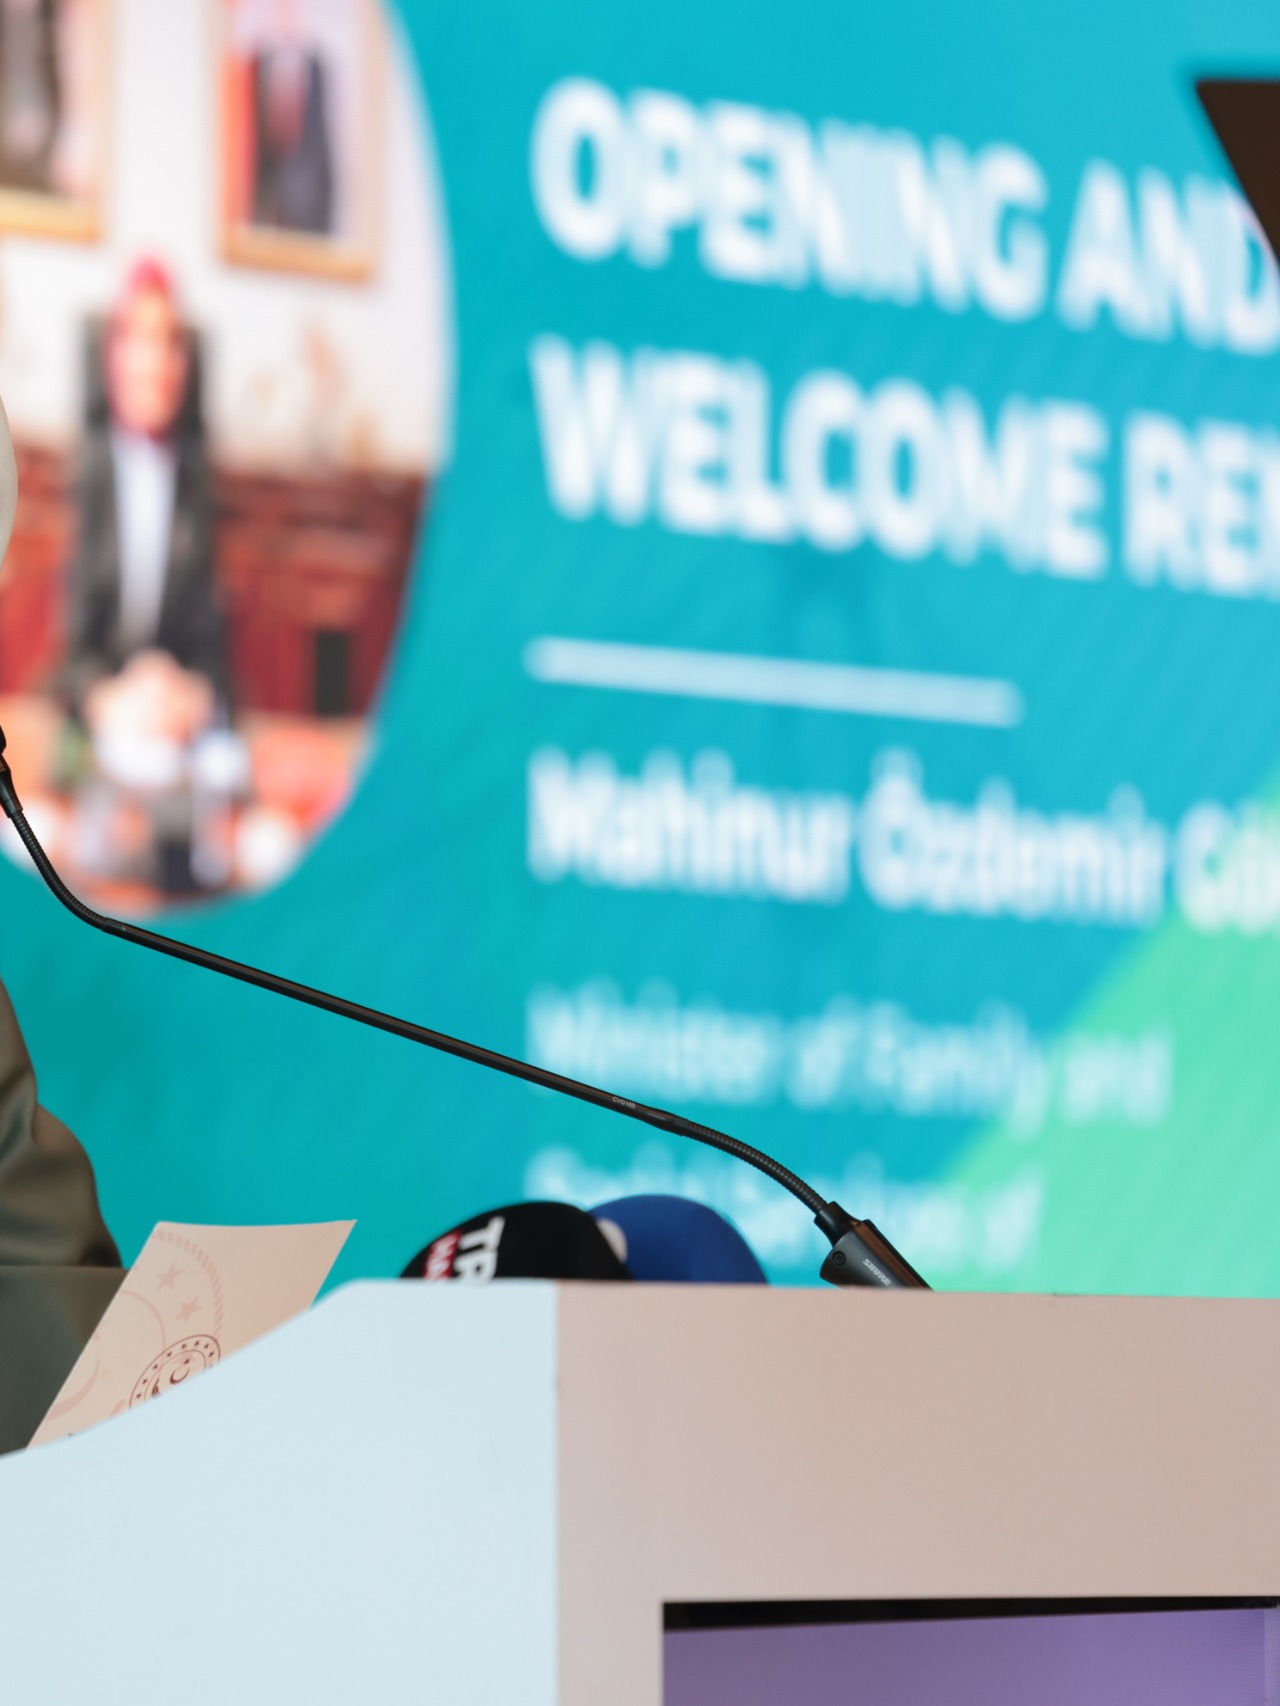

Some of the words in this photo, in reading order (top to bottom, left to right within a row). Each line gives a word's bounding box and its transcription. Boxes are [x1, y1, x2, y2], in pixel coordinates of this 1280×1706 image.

[532, 78, 1050, 320] OPENING
[1058, 160, 1280, 354] AND
[528, 336, 1110, 580] WELCOME
[1122, 411, 1280, 600] RE
[862, 1258, 892, 1287] SHURE
